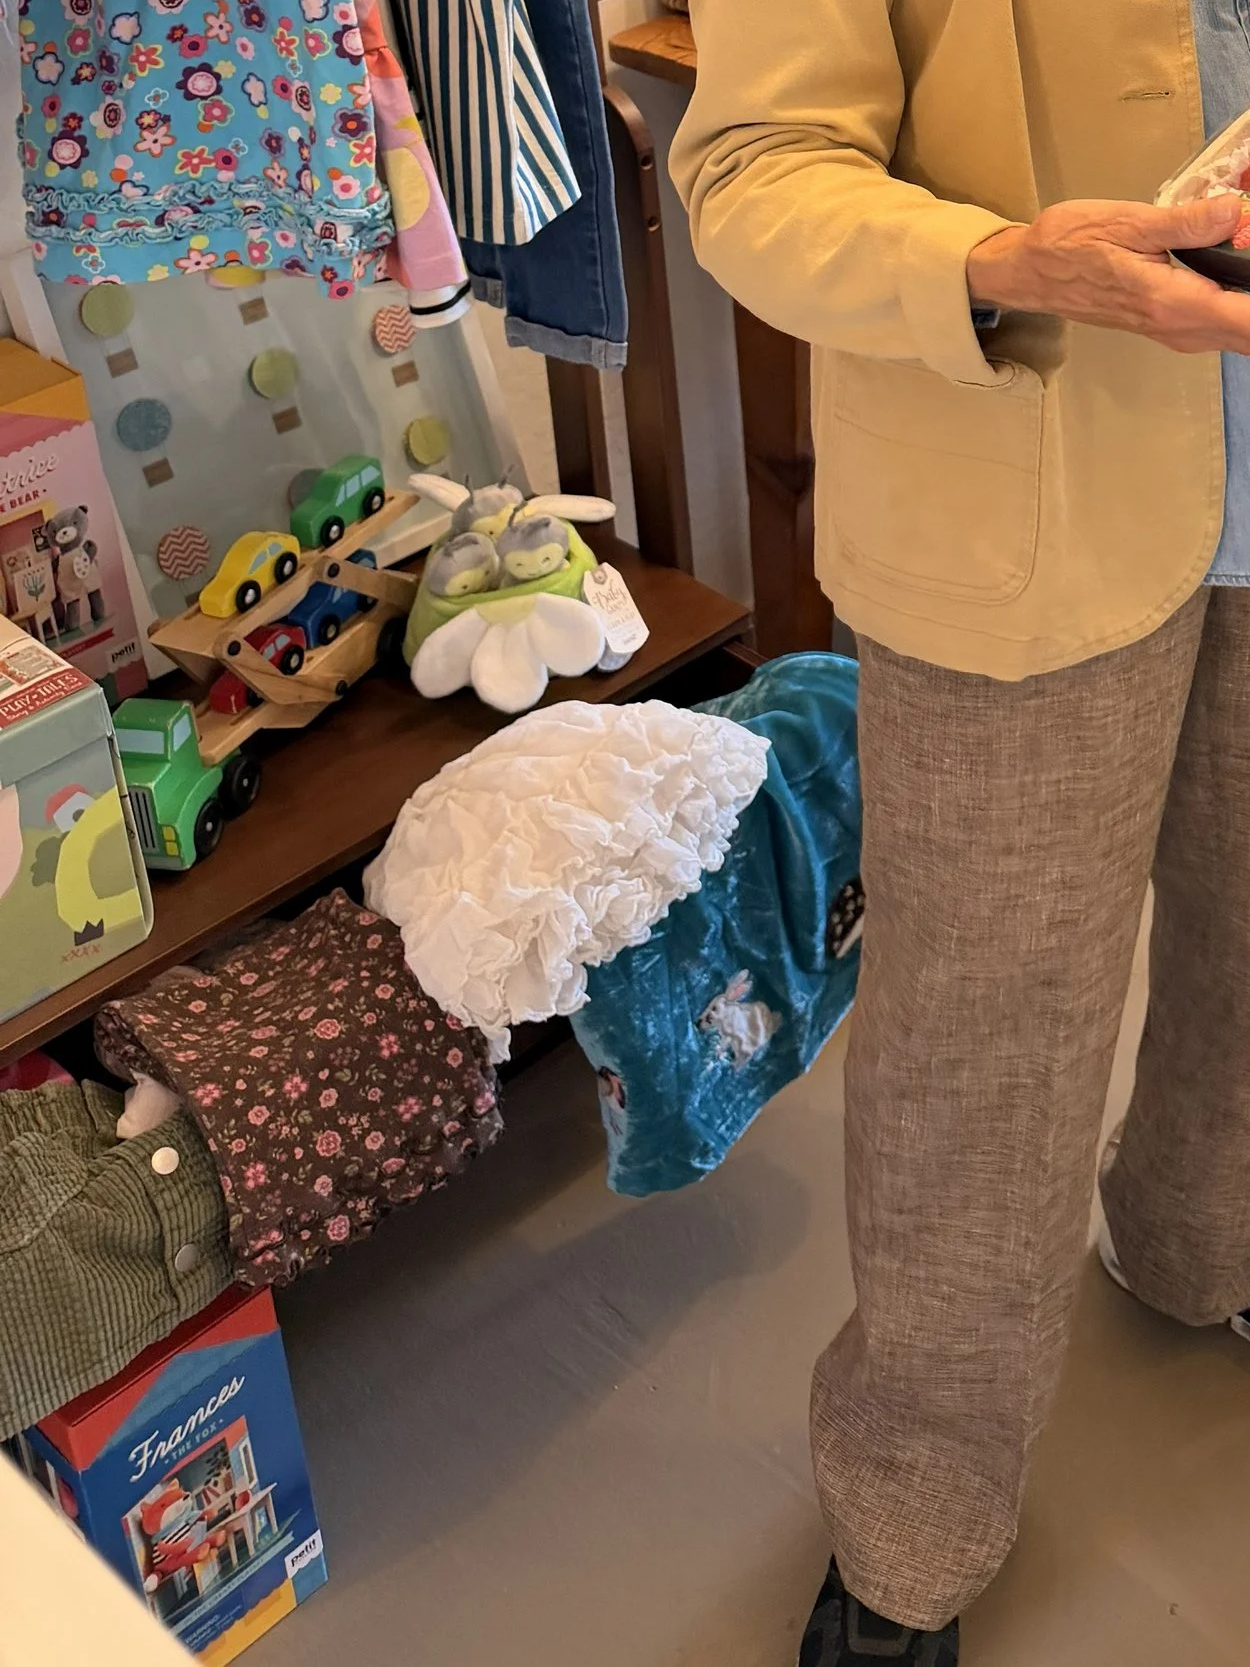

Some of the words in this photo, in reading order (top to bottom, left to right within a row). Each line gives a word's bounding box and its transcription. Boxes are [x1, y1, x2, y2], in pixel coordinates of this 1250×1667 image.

[9, 489, 40, 509] BEAR
[111, 641, 135, 663] petit
[127, 1375, 246, 1483] Frances
[171, 1440, 193, 1460] THE
[194, 1421, 218, 1443] FOX
[290, 1538, 317, 1568] petit
